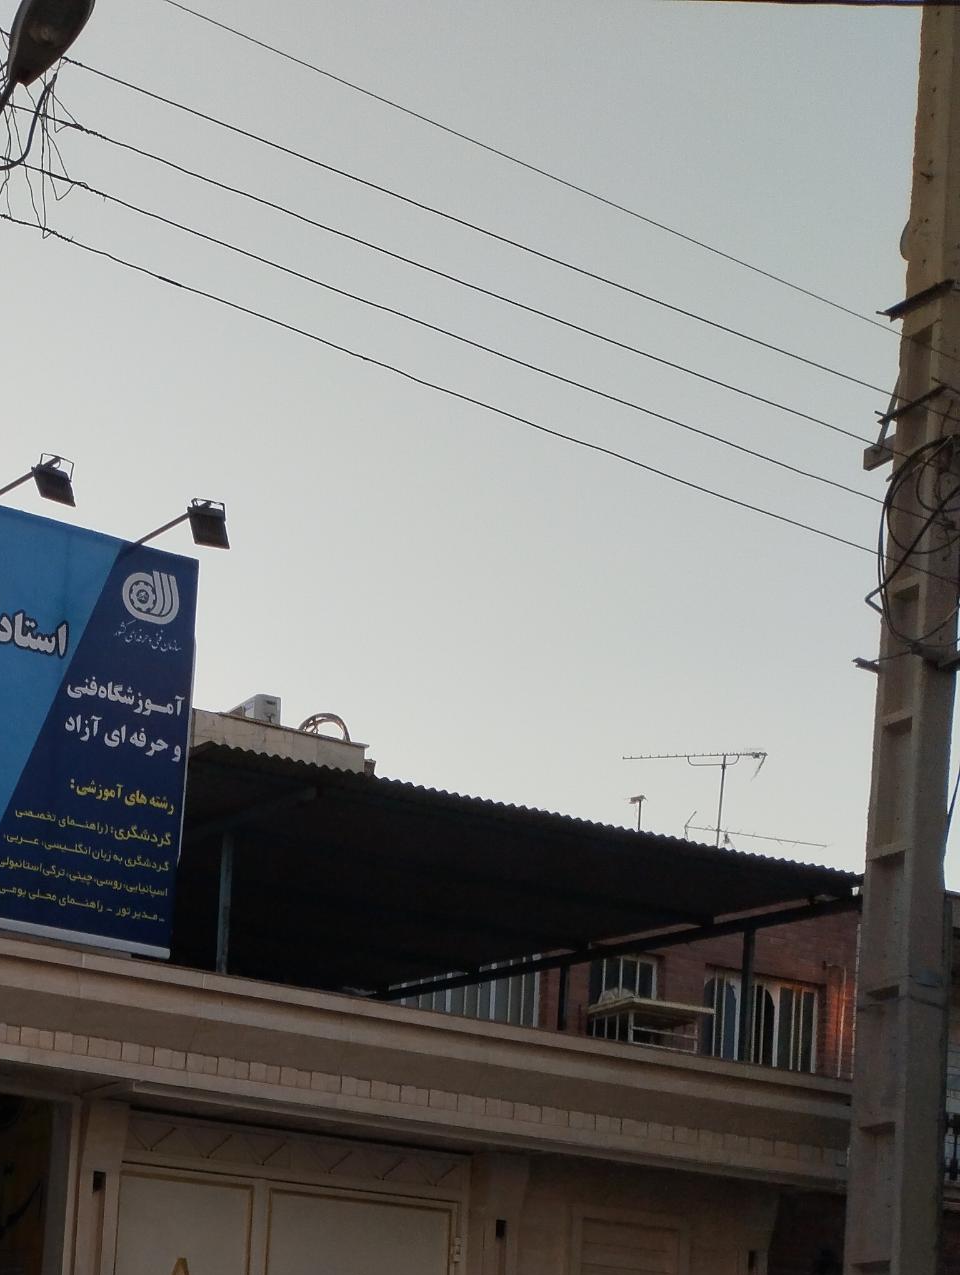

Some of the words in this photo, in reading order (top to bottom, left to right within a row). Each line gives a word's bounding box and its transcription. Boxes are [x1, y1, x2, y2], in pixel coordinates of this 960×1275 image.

[67, 676, 98, 698] فنی
[98, 681, 185, 716] آموزشگاه
[65, 714, 103, 741] آزاد
[104, 724, 127, 747] ای
[129, 727, 168, 756] حرفه
[171, 745, 181, 762] و
[70, 778, 123, 801] آموزشی:
[124, 790, 147, 806] های
[149, 796, 175, 814] رشته
[15, 808, 56, 822] تخصصی
[111, 824, 171, 847] گردشگری:
[92, 849, 111, 862] زبان
[112, 855, 123, 863] به
[125, 855, 169, 872] گردشگری
[42, 864, 65, 878] ترکی
[28, 888, 56, 901] محلی
[58, 895, 103, 912] راهنمای
[116, 906, 130, 916] تور
